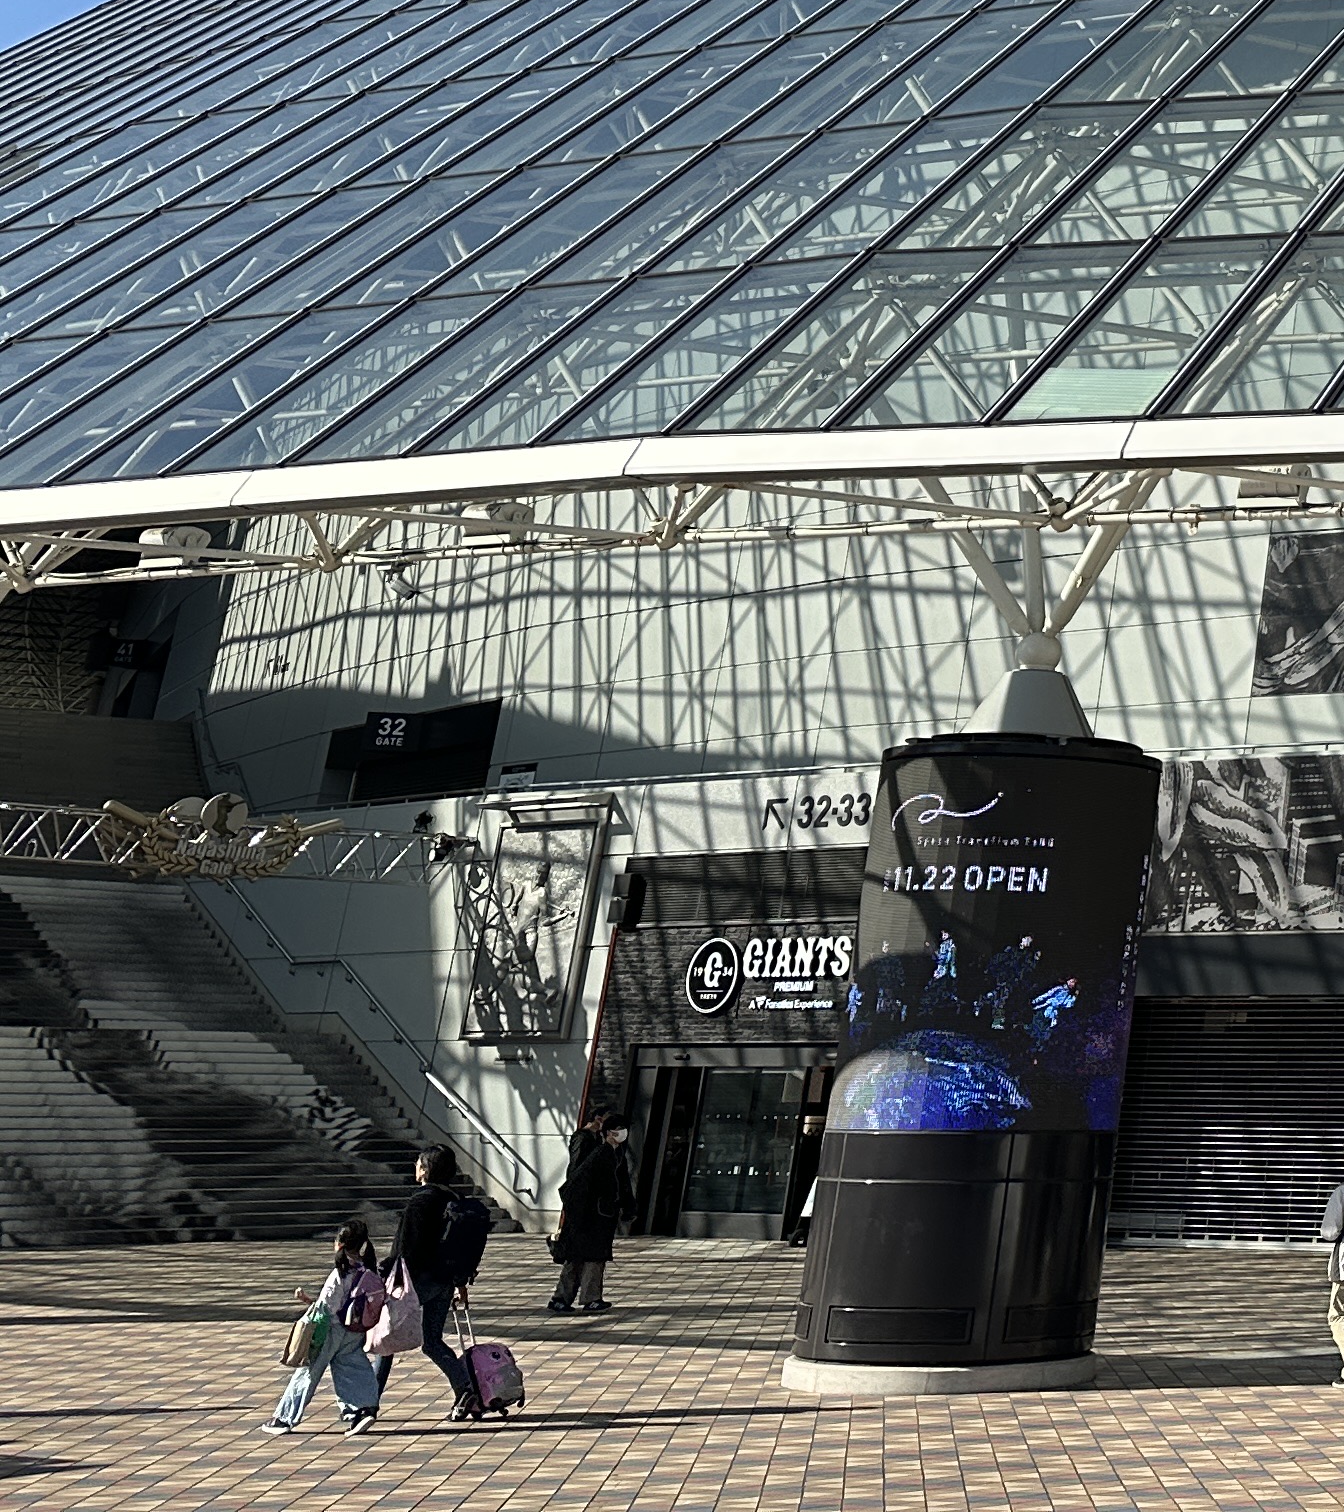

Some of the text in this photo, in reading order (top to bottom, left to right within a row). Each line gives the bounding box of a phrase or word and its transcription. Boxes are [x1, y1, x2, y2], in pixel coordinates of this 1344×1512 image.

[378, 717, 405, 736] 32
[375, 737, 403, 747] GATE
[200, 859, 233, 875] Gate
[893, 865, 957, 891] 11.22
[963, 865, 1049, 892] OPEN
[743, 936, 853, 978] GIANTS
[703, 952, 723, 988] G
